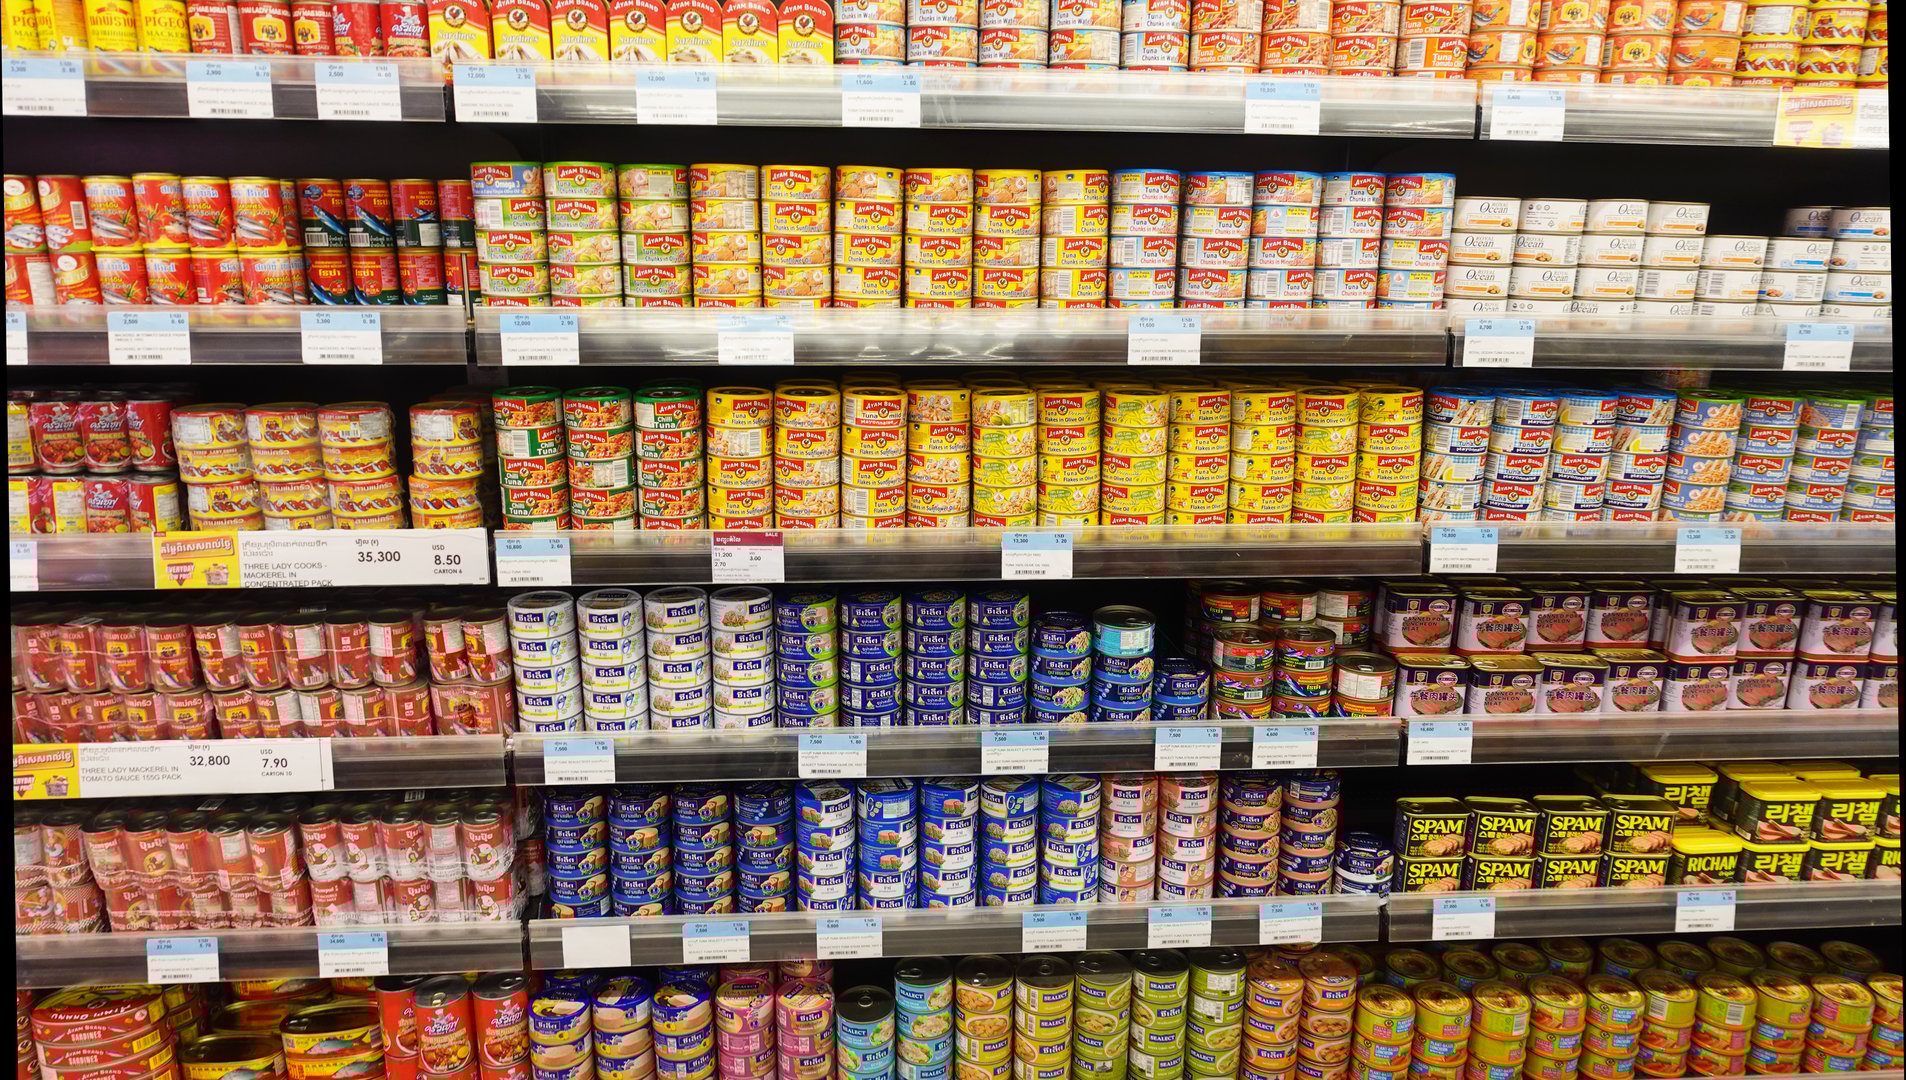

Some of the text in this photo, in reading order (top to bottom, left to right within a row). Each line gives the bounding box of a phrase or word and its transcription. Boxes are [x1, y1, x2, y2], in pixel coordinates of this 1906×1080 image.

[728, 2, 770, 14] AYAM BRAND
[783, 4, 826, 16] AYAM BRAND
[438, 31, 476, 41] Sardines
[561, 35, 597, 44] Sardines
[912, 28, 947, 40] AYAM BRAND
[675, 36, 712, 46] Sardines
[730, 38, 768, 47] Sardines
[787, 40, 823, 49] Sardines
[1270, 36, 1306, 47] AYAM BRAND
[560, 168, 600, 178] AYAM BRAND
[985, 271, 1021, 282] AYAM BRAND
[659, 404, 676, 412] AYAM
[1061, 398, 1080, 408] BRAND
[358, 551, 400, 563] 35,300
[434, 555, 461, 565] 8.50
[190, 756, 230, 767] 32,800
[262, 758, 288, 768] 7.90
[1665, 785, 1711, 804] 리챔
[1766, 803, 1814, 824] 리챔
[1831, 801, 1879, 822] 리챔
[1412, 819, 1464, 834] SPAM
[1480, 816, 1533, 833] SPAM
[1550, 816, 1602, 831] SPAM
[1616, 815, 1669, 830] SPAM
[1547, 859, 1597, 874] SPAM
[1613, 859, 1665, 874] SPAM
[1755, 853, 1803, 873] 리챔
[1408, 863, 1459, 877] SPAM
[1478, 862, 1530, 877] SPAM
[901, 989, 924, 999] SEALECT
[1044, 992, 1068, 1001] SEALECT
[1081, 986, 1106, 996] SEALECT
[1256, 996, 1281, 1006] SEALECT
[72, 1031, 102, 1041] SARDINES
[843, 1026, 867, 1036] SEALECT
[985, 1041, 1007, 1050] SEALECT
